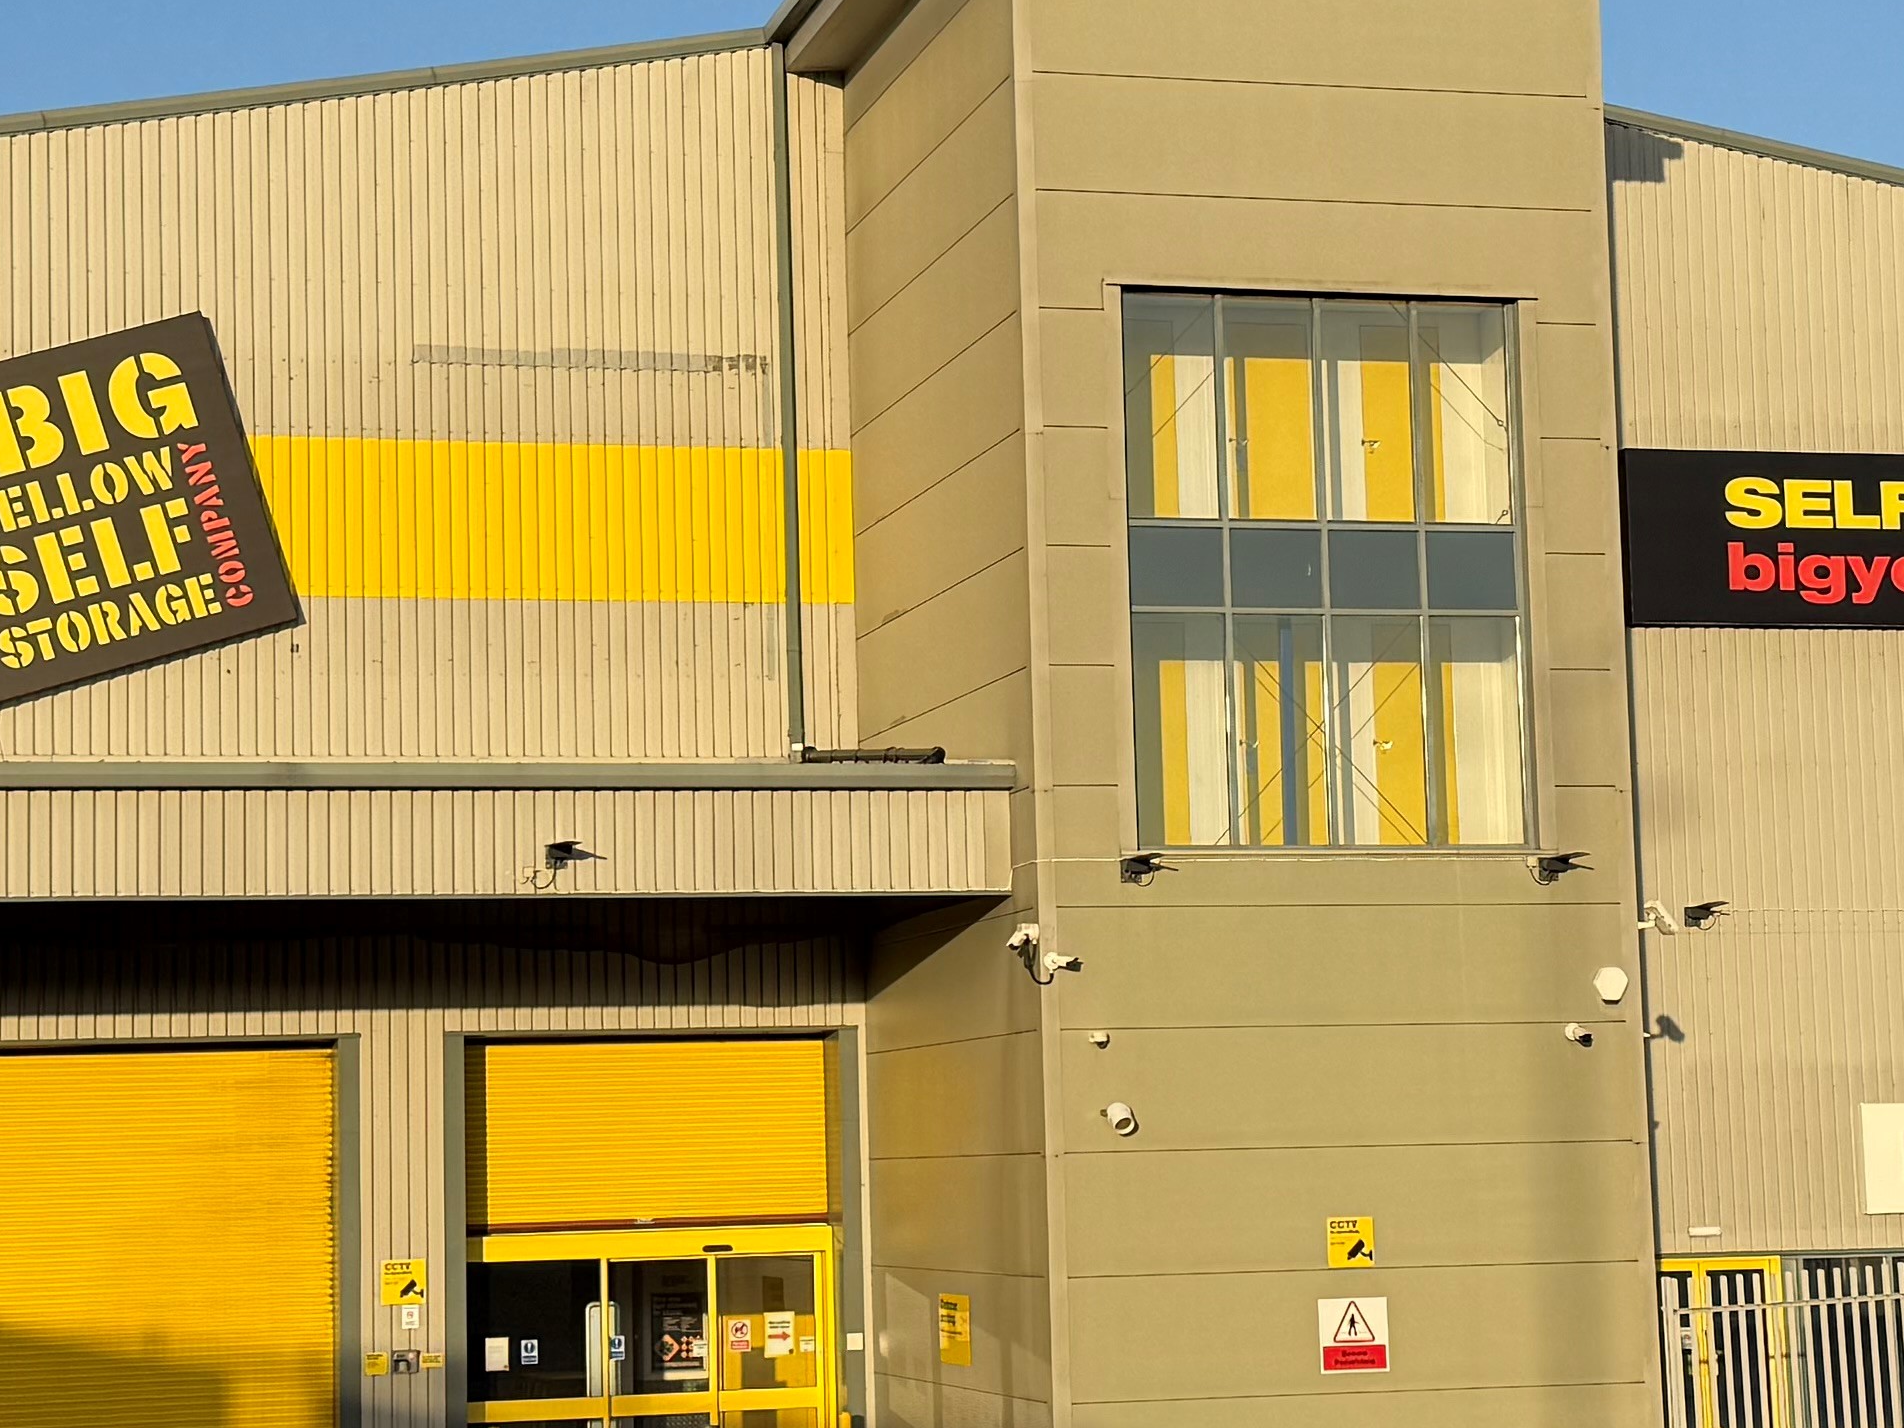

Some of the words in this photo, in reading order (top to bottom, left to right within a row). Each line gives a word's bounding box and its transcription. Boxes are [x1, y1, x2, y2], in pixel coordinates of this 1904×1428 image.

[176, 442, 254, 608] COMPANY
[1330, 1220, 1357, 1229] CCTV
[384, 1262, 411, 1271] CCTV
